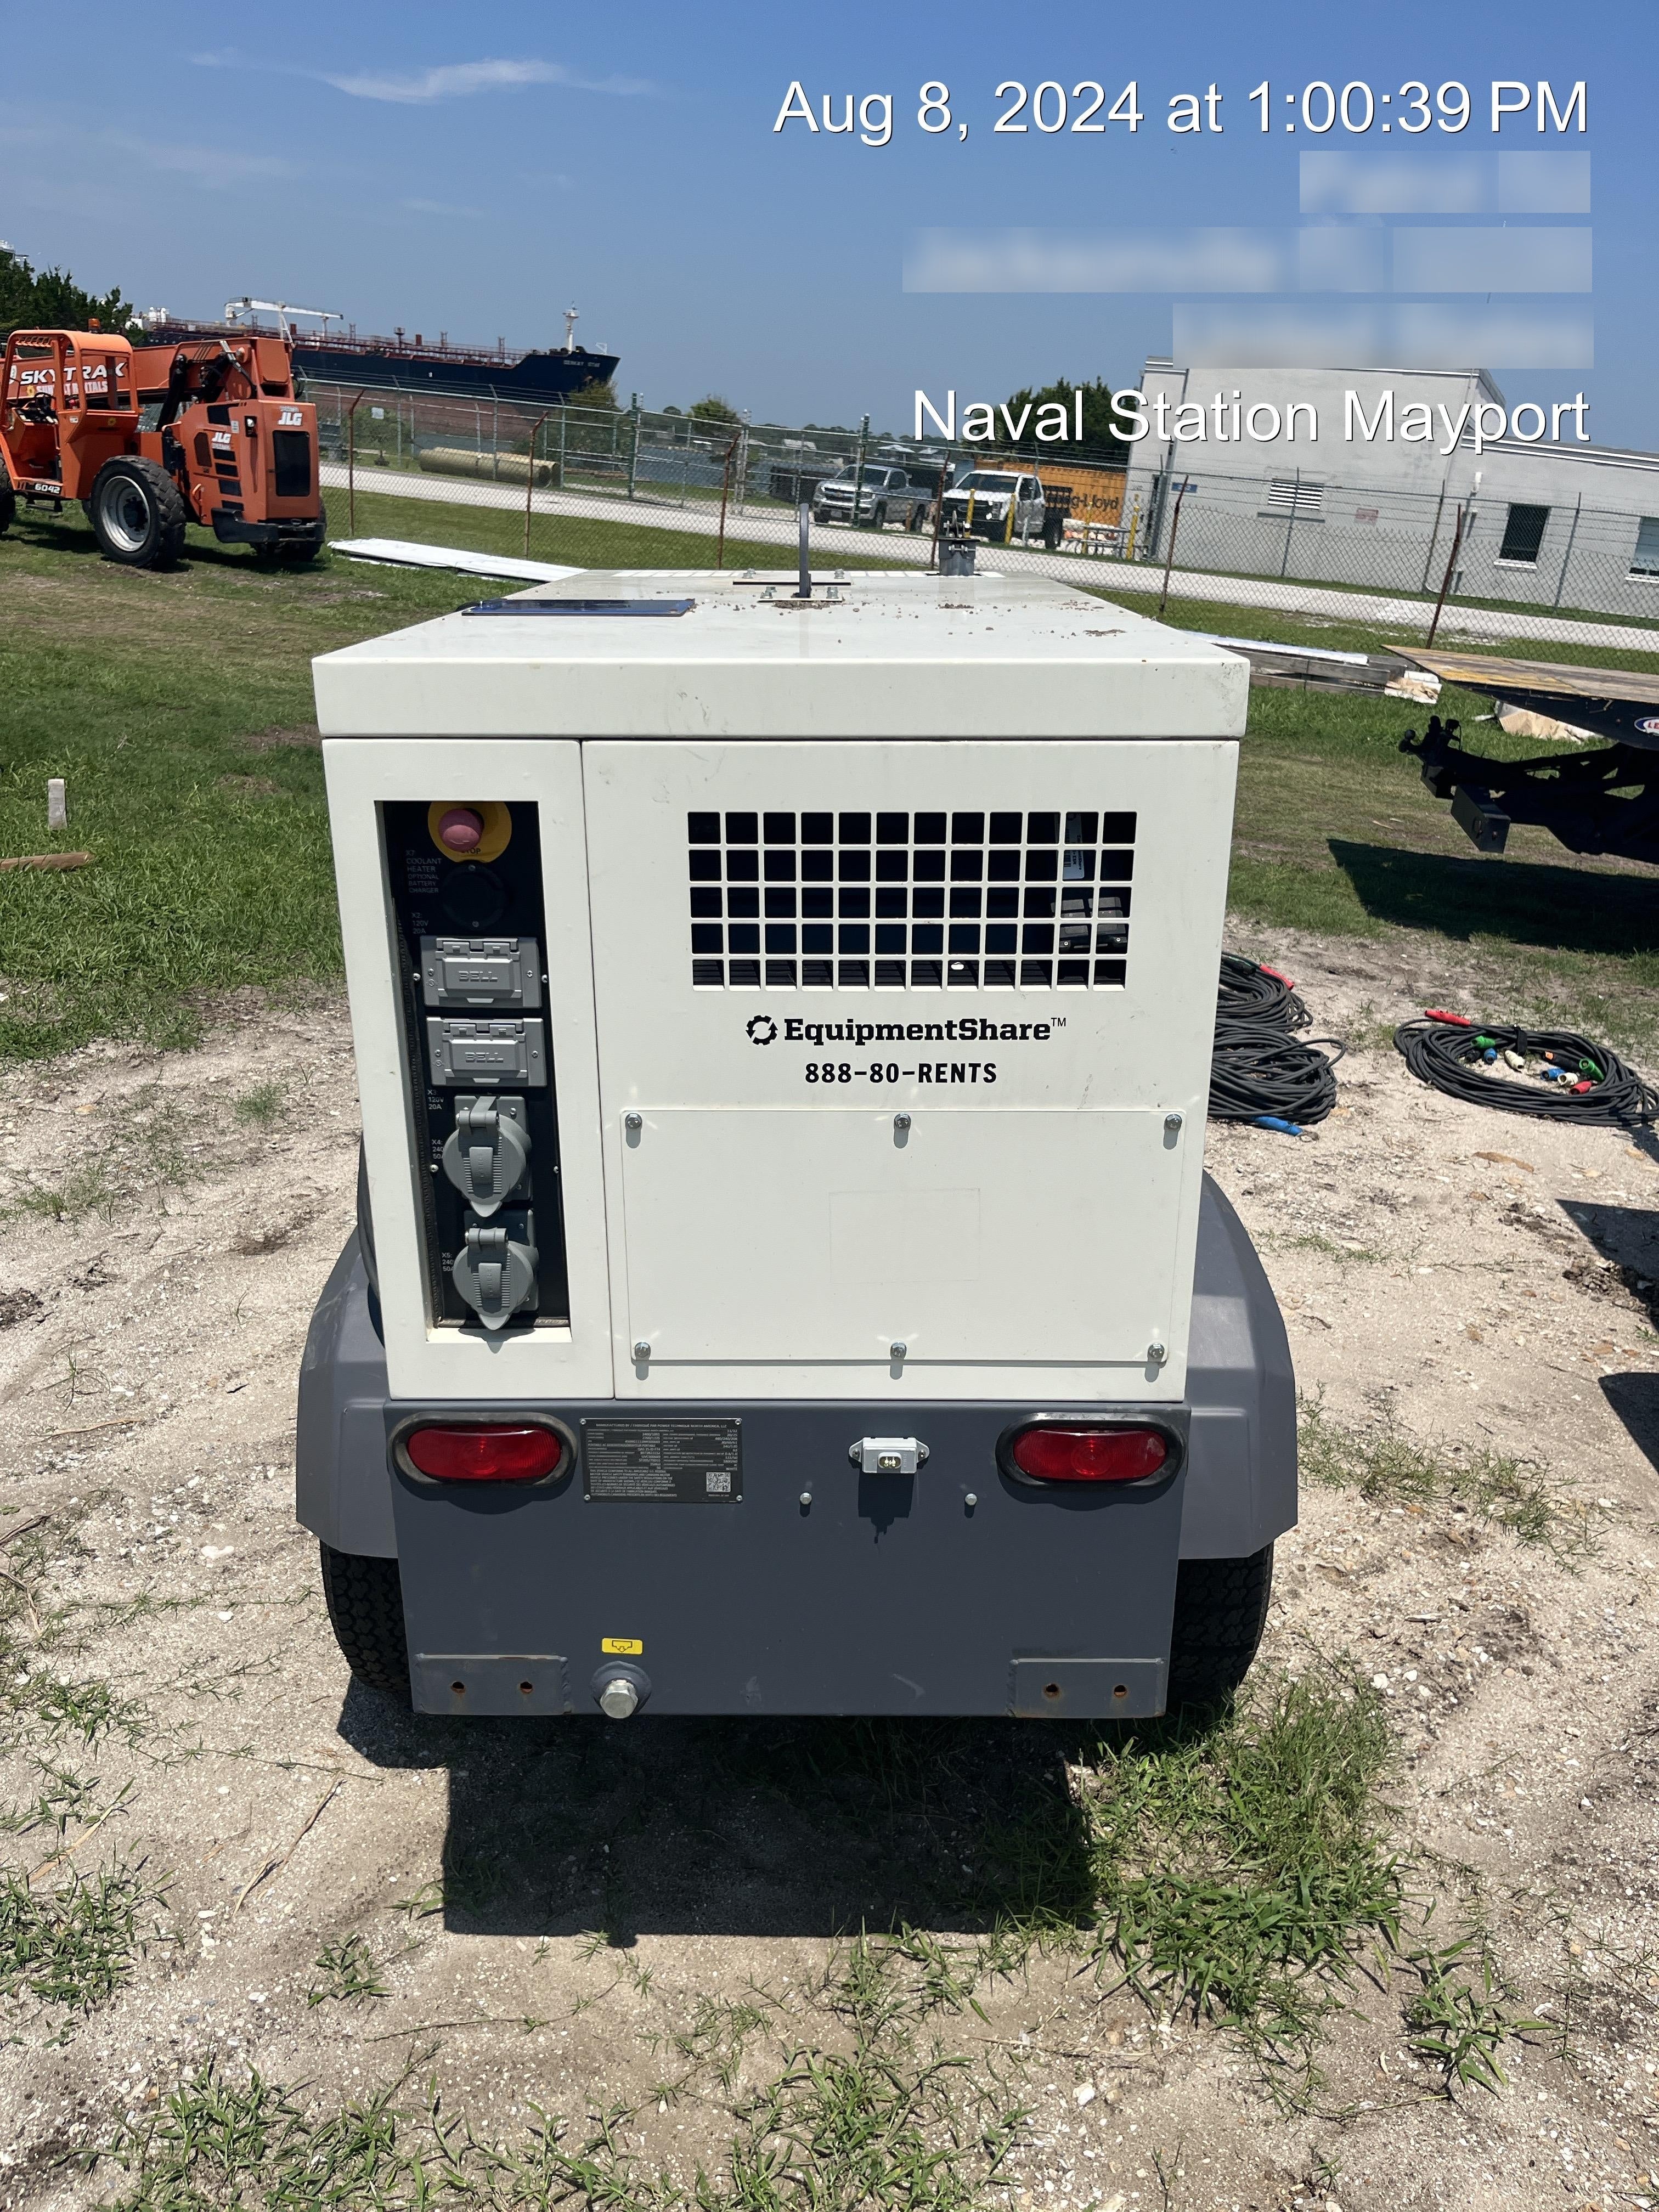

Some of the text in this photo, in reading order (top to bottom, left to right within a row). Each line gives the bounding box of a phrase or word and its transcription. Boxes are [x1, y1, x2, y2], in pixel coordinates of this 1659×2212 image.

[277, 411, 303, 426] JLG
[211, 432, 232, 444] JLG
[35, 483, 61, 494] 6042
[458, 971, 498, 983] BELL
[465, 1052, 504, 1063] BELL
[805, 1063, 997, 1084] 888-80-RENTS
